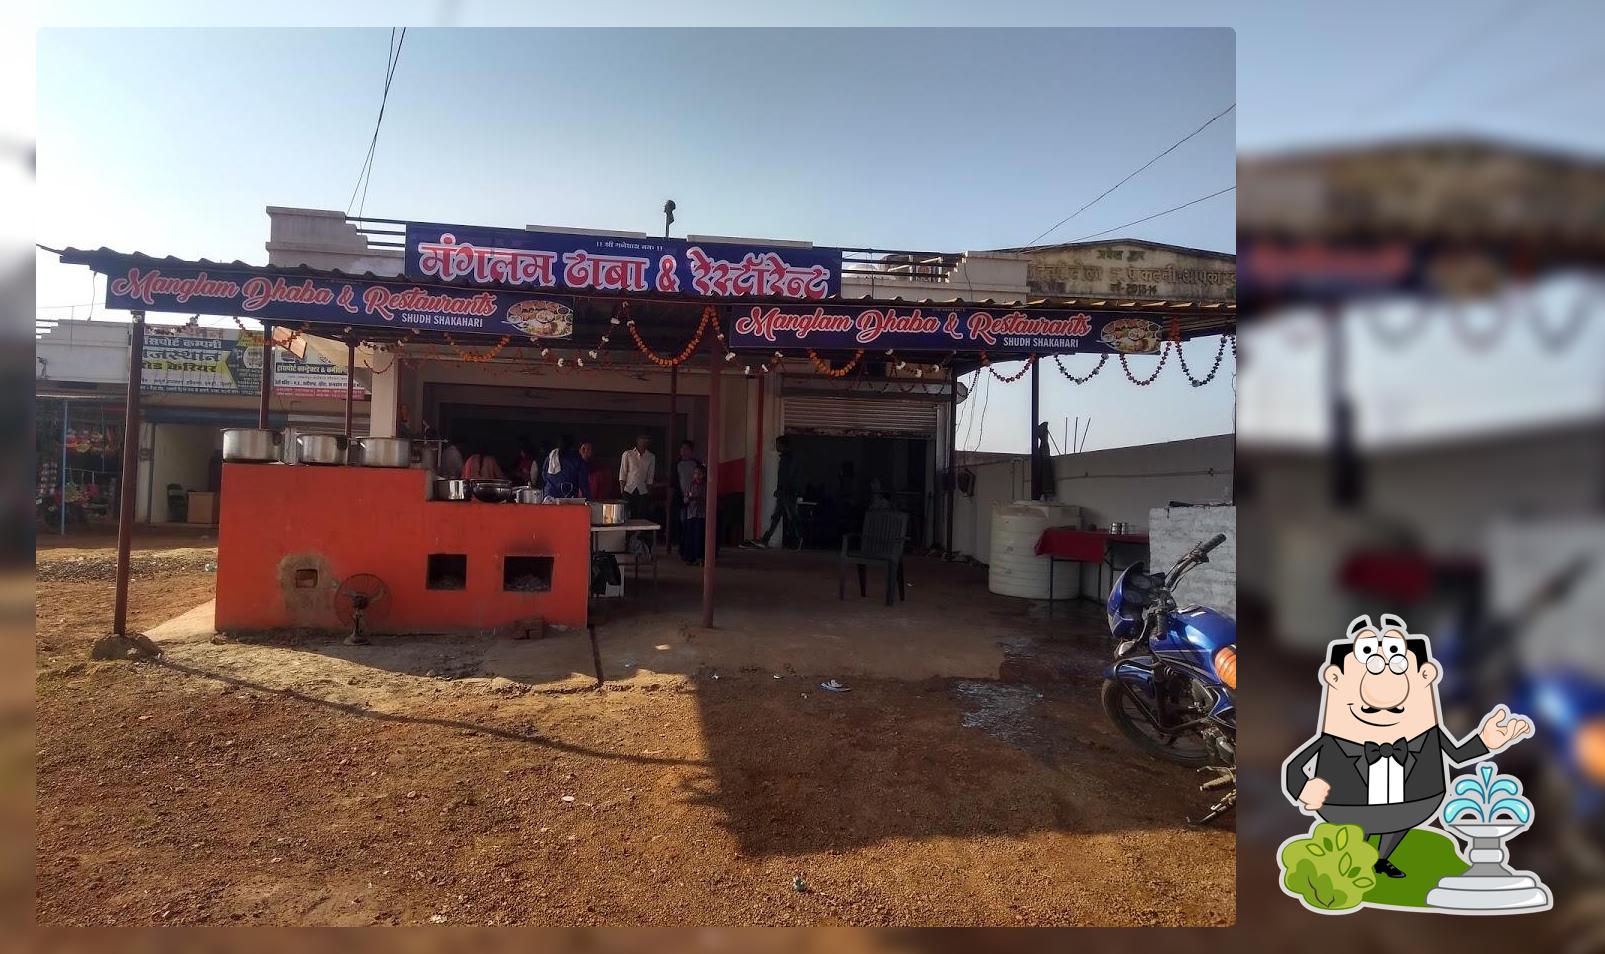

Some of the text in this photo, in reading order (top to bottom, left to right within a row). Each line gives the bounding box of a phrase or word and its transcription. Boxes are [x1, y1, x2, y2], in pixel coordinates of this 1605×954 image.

[418, 233, 557, 287] मंगलम
[562, 249, 650, 291] ढाबा
[656, 254, 680, 292] &
[111, 267, 498, 320] Manglam Dhaba & Restaurants
[401, 312, 483, 328] SHUDH SHAKAHARI
[736, 306, 1092, 345] Manglam Dhaba & Restaurants
[1003, 337, 1079, 348] SHUDH SHAKAHARI
